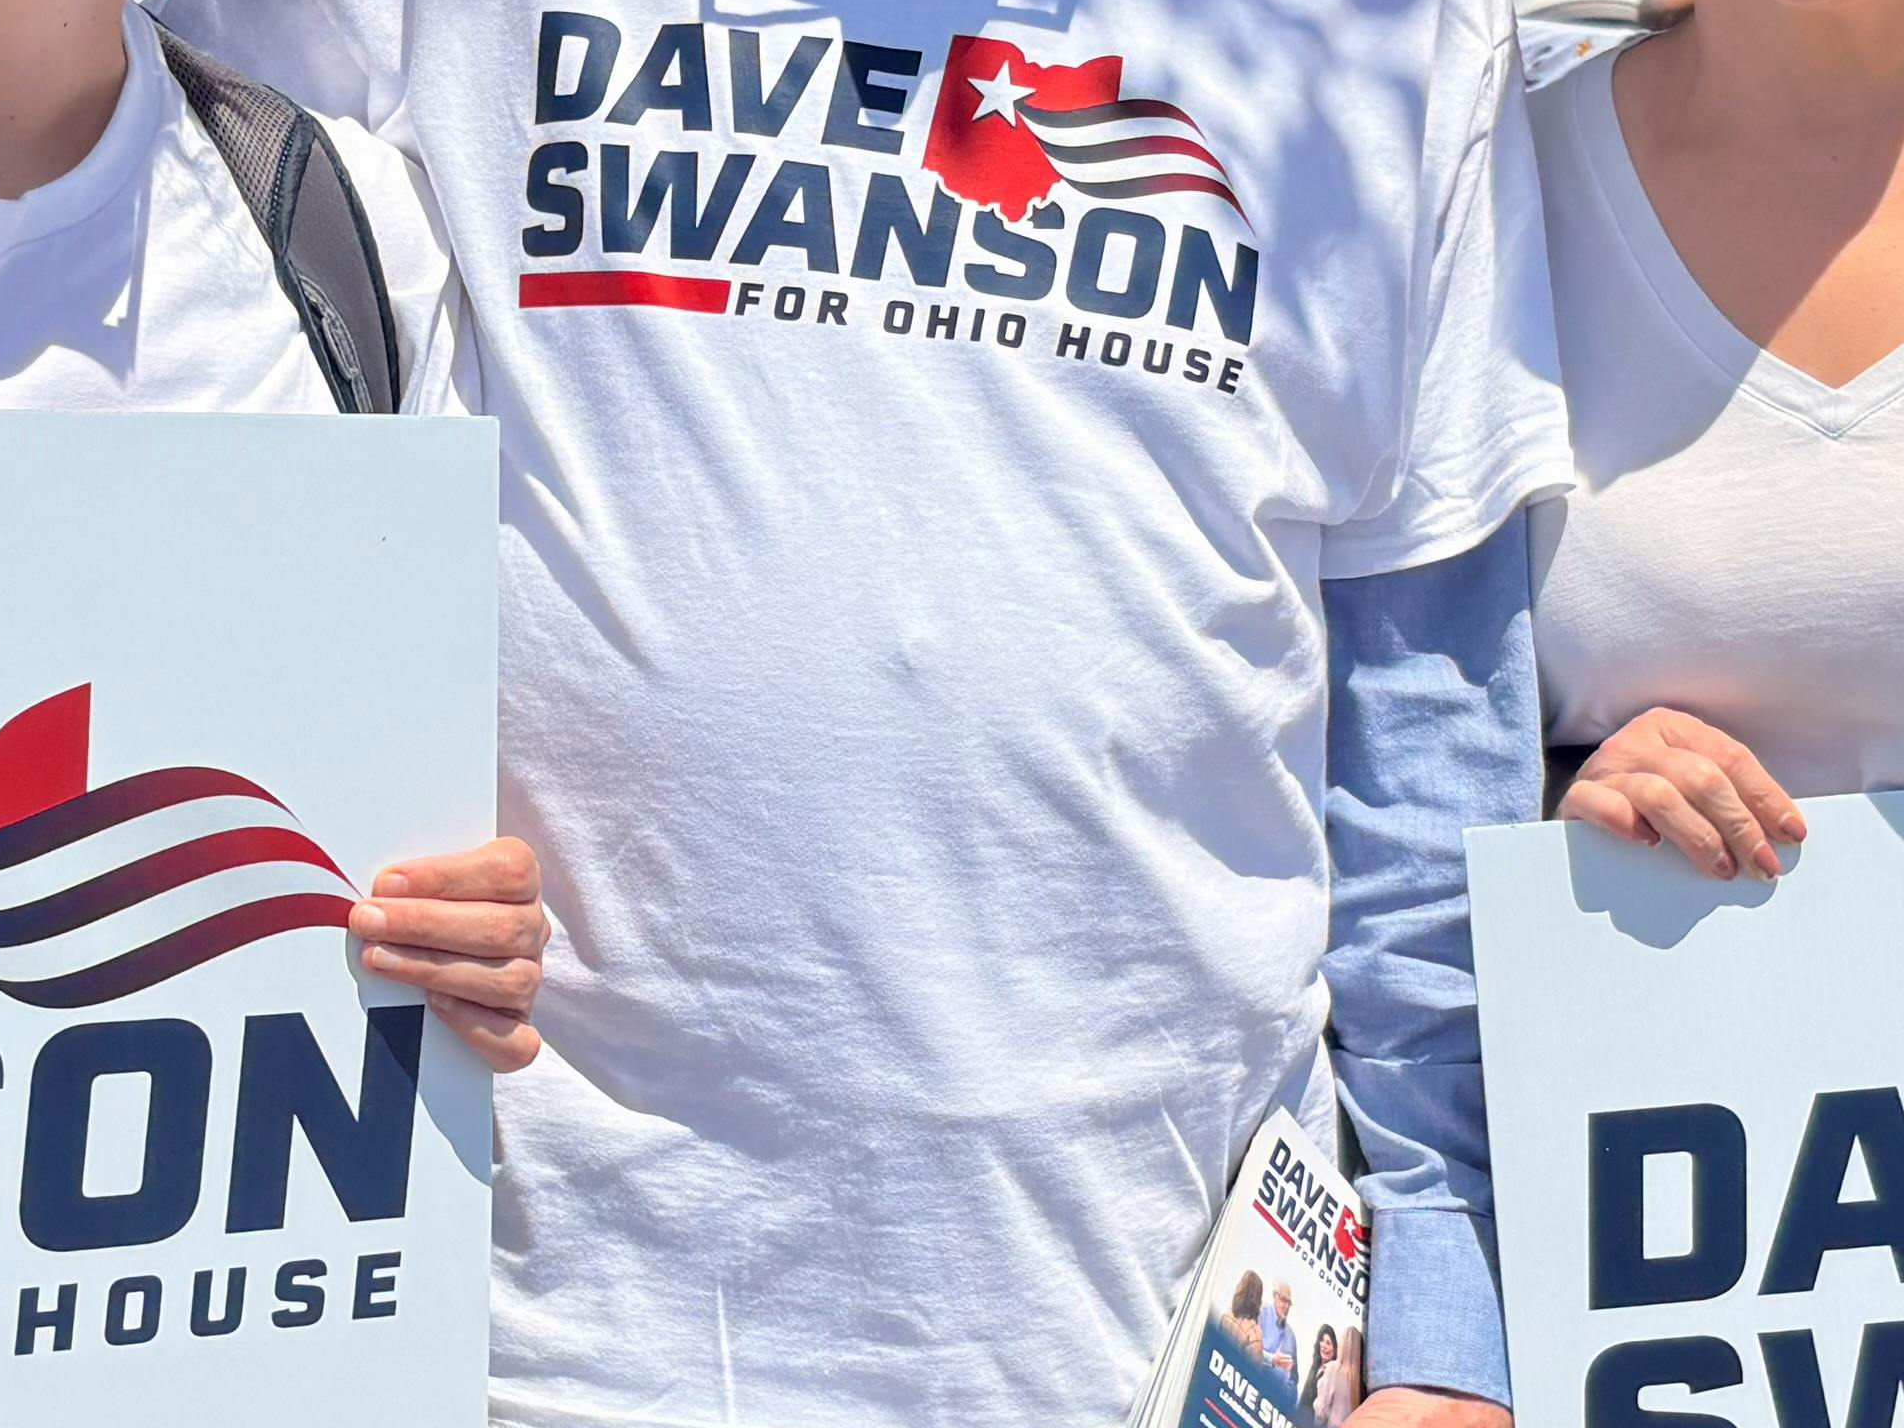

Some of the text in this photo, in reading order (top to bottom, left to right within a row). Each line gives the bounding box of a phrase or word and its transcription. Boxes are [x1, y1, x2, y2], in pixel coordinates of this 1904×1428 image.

[534, 11, 923, 154] DAVE
[522, 141, 1259, 346] SWANSON
[735, 283, 1244, 394] FOR OHIO HOUSE
[1258, 1170, 1370, 1304] SWANSO
[1269, 1137, 1338, 1229] DAVE
[15, 1251, 402, 1356] HOUSE
[1209, 1349, 1259, 1411] DAVE
